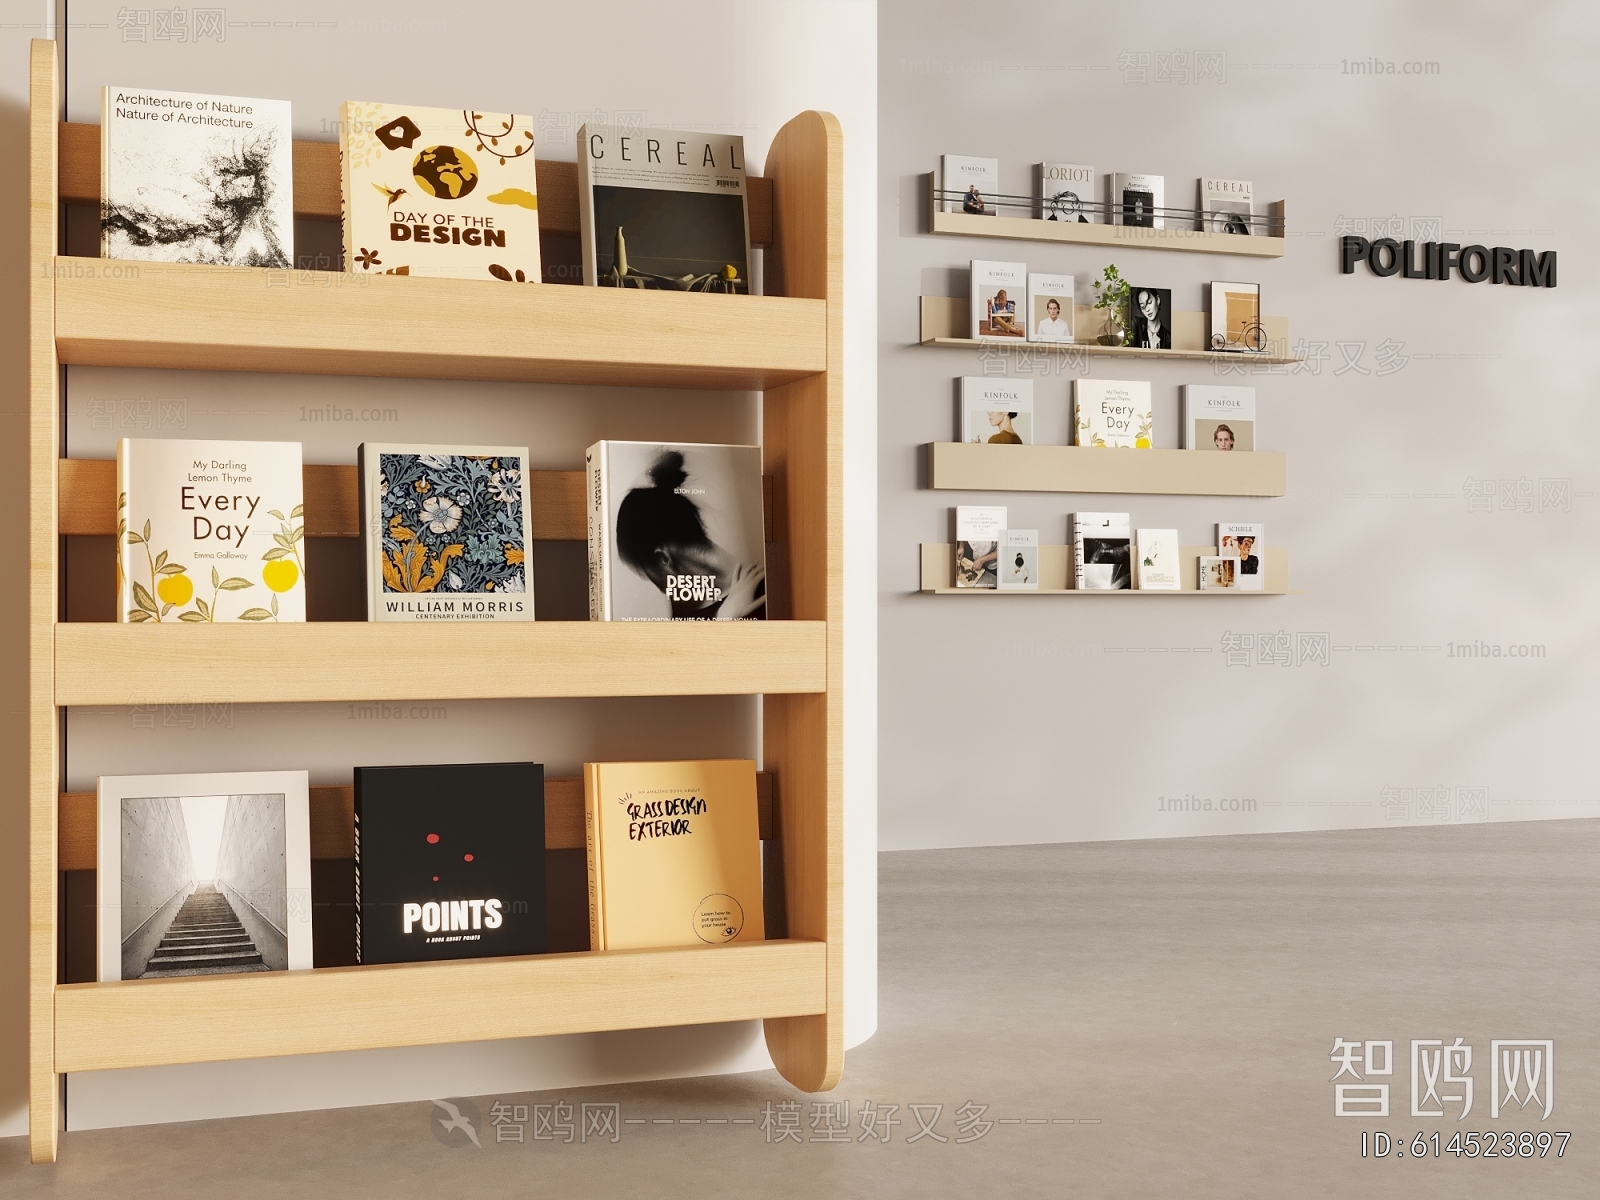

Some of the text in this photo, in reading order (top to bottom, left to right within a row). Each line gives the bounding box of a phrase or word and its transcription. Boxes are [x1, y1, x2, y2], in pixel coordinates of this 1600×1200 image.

[116, 93, 254, 115] Architecture of Nature
[116, 107, 254, 129] Nature of Architecture
[590, 134, 742, 170] CEREAL
[1042, 166, 1093, 183] LORIOT
[1207, 180, 1251, 194] CEREAL
[393, 211, 494, 229] DAY OF THE
[390, 222, 506, 248] DESIGN
[1340, 234, 1557, 288] POLIFORM
[984, 391, 1019, 400] KINFOLK
[1207, 399, 1242, 408] KINFOLK
[1101, 401, 1135, 419] Every
[1106, 416, 1130, 432] Day
[192, 460, 247, 472] My Darling
[188, 472, 252, 485] Lemon Thyme
[181, 486, 261, 519] Every
[193, 516, 250, 549] Day
[216, 552, 248, 561] Galloway
[666, 575, 716, 589] DESERT
[666, 587, 722, 601] FLOWER
[386, 601, 524, 613] WILLIAM MORRIS
[627, 796, 707, 822] GRASS DESIGN
[629, 818, 693, 842] EXTERIOR
[589, 860, 595, 875] of
[403, 898, 503, 934] POINTS
